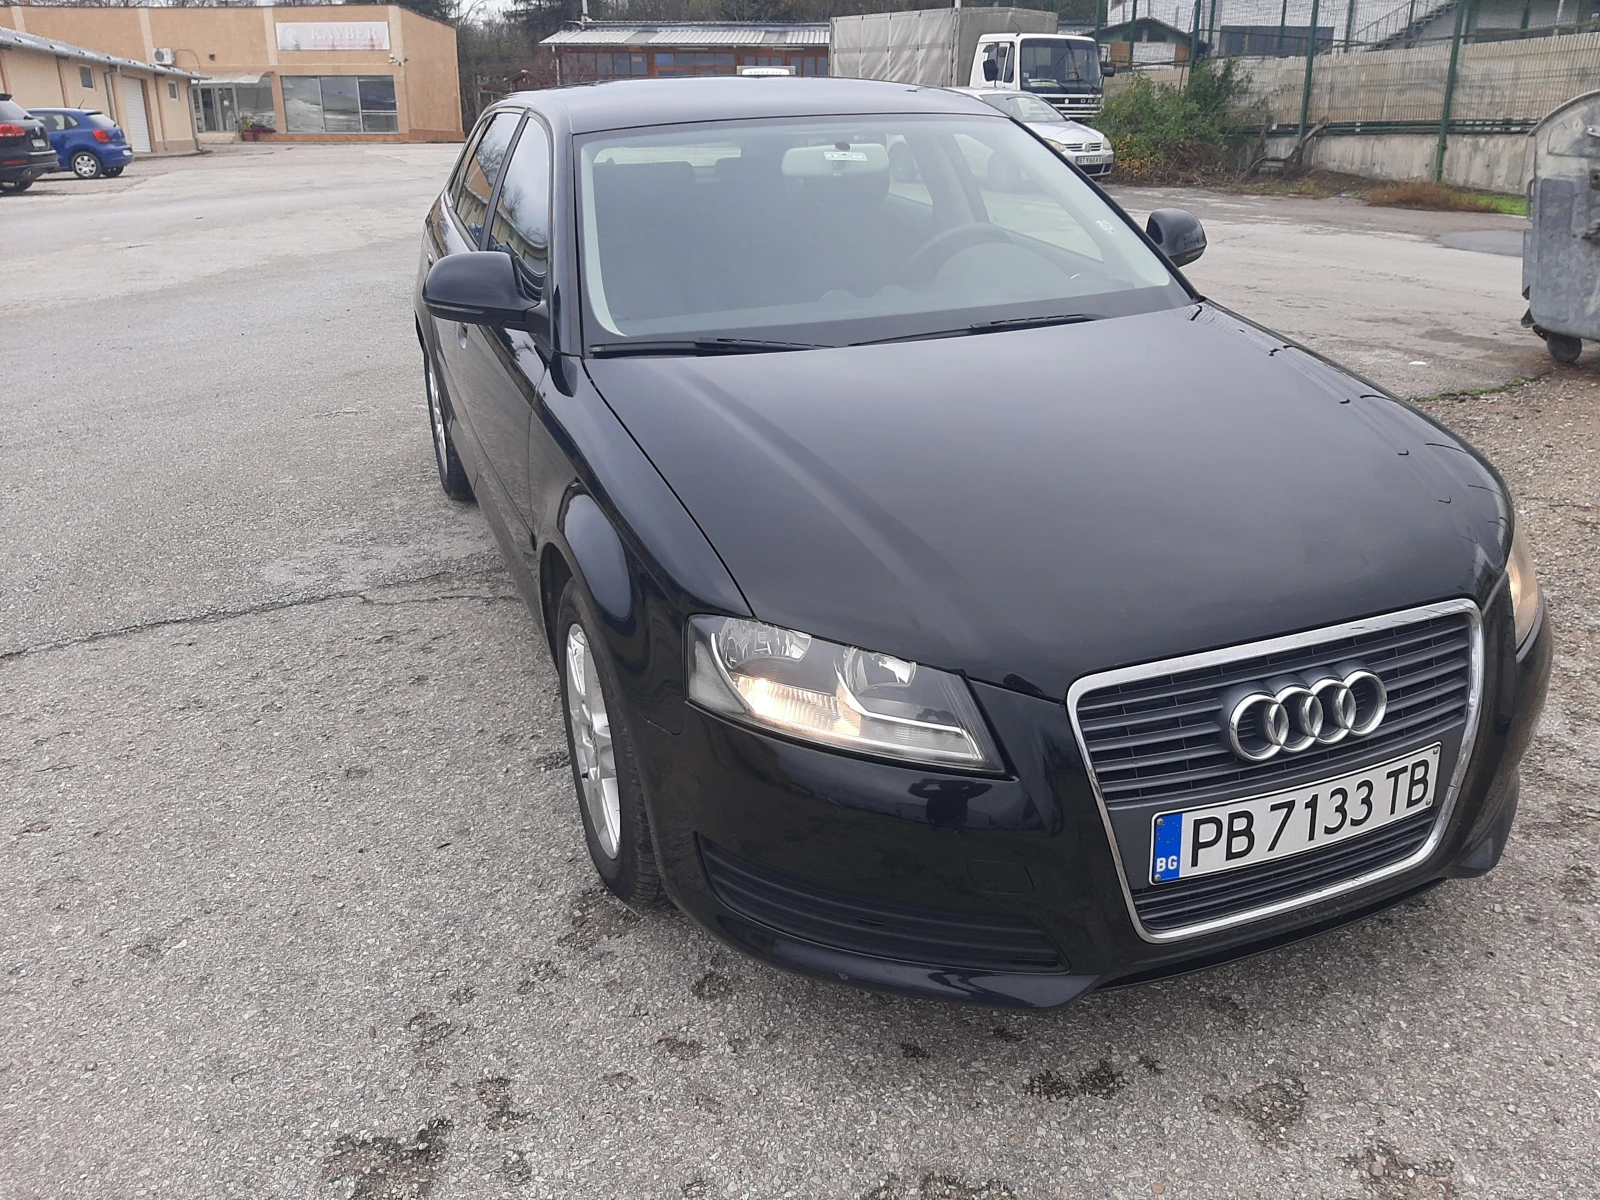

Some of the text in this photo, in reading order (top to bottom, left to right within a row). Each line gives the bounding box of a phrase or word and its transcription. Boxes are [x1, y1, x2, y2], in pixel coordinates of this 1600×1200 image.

[1190, 759, 1430, 868] PB 7133 TB
[1156, 856, 1178, 873] BG
